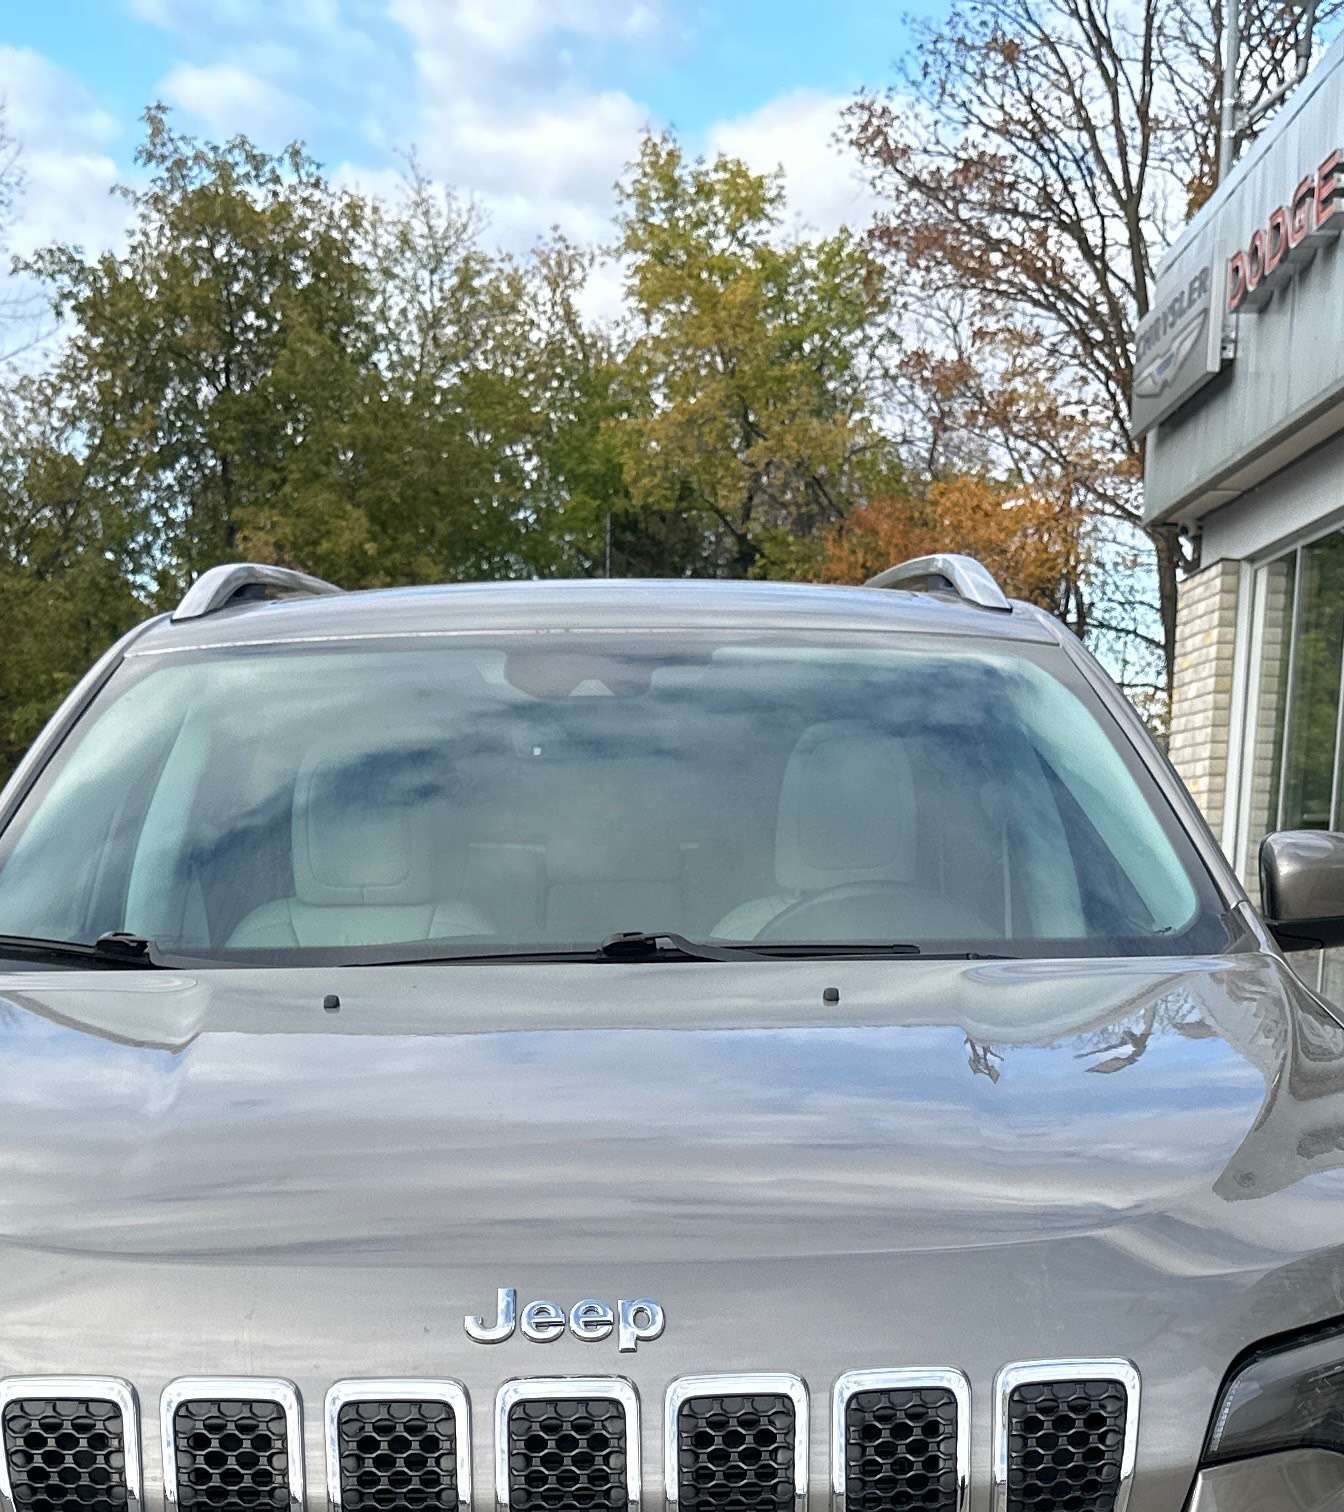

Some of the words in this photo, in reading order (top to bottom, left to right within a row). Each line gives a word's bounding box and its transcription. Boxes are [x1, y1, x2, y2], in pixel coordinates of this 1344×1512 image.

[1227, 148, 1342, 313] DODGE
[1136, 265, 1209, 363] CHRYSLER
[464, 1287, 666, 1353] Jeep
